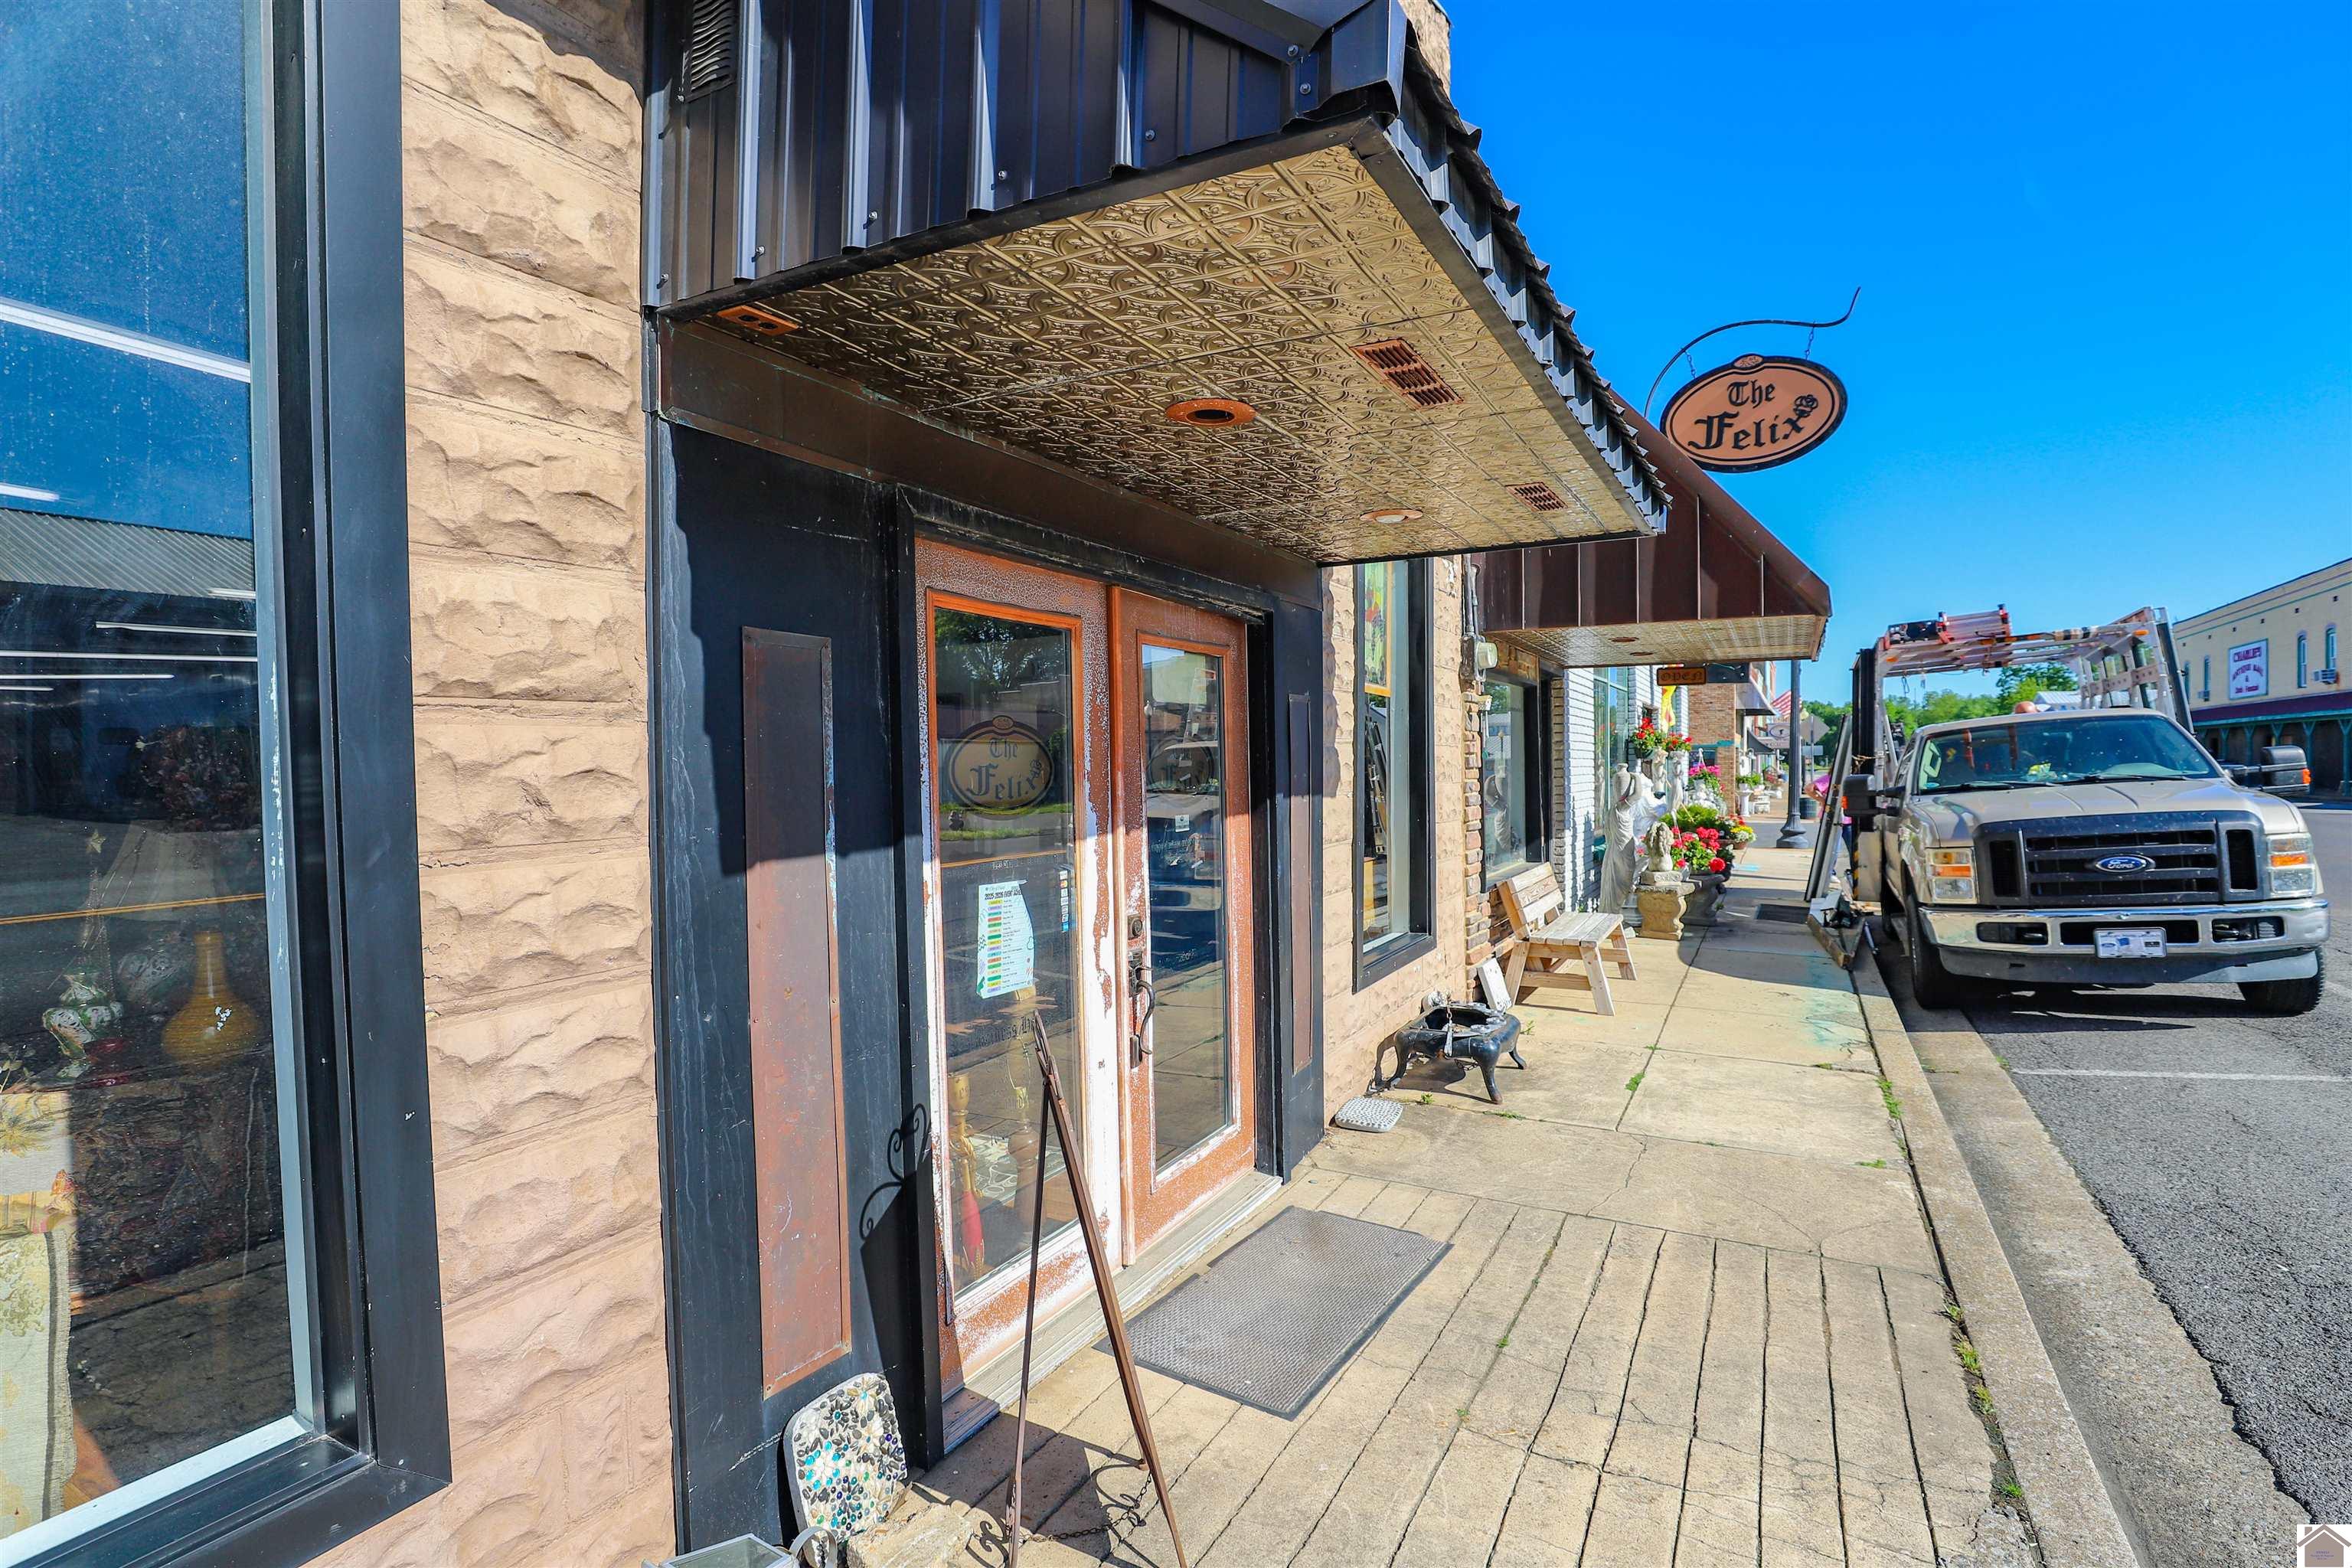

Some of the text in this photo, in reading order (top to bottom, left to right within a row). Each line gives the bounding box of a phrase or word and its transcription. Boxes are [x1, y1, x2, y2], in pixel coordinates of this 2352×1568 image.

[1727, 380, 1776, 409] The
[1687, 410, 1804, 450] Felix
[989, 737, 1018, 760] The
[966, 763, 1036, 801] Felix
[2107, 859, 2134, 869] Ford
